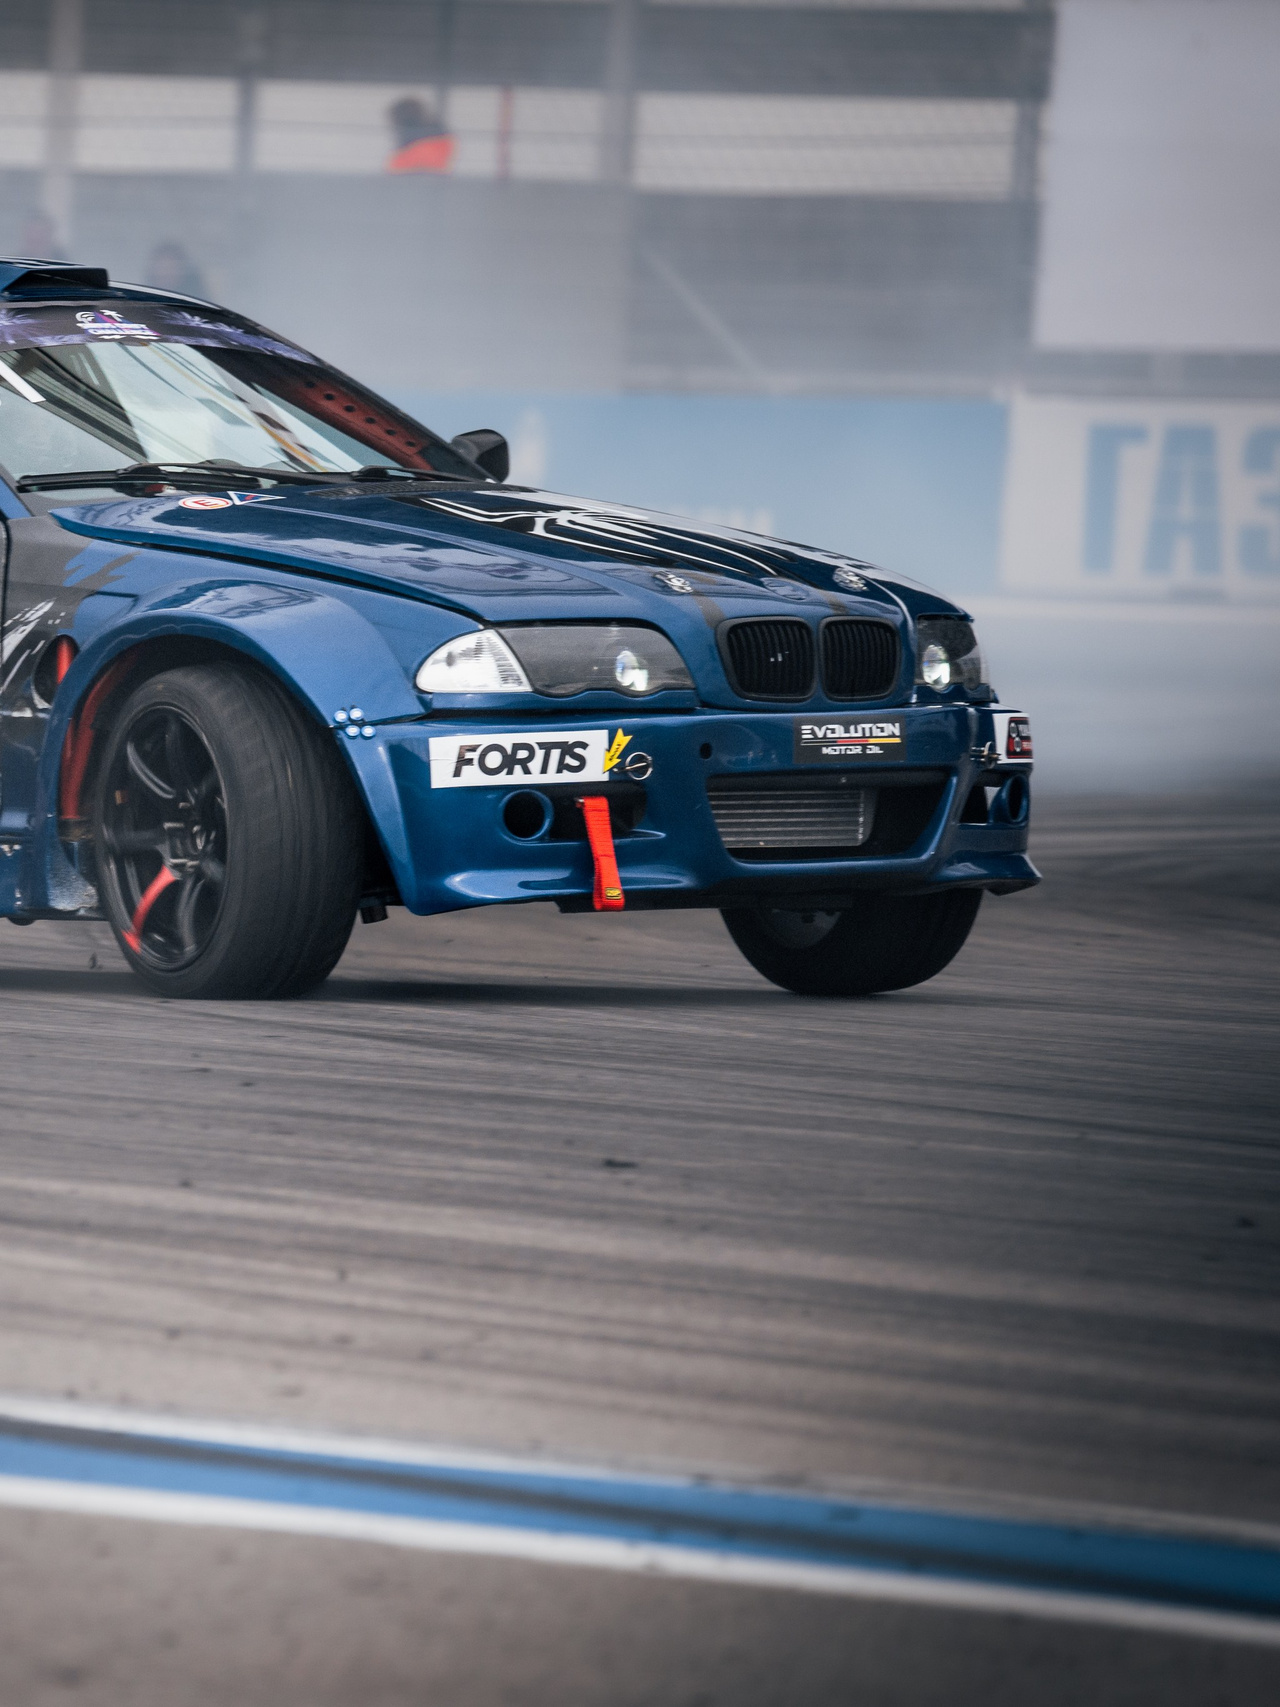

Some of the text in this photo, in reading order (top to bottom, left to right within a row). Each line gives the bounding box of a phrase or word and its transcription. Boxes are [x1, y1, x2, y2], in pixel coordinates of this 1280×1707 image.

[800, 723, 900, 738] EVOLUTION
[822, 745, 884, 754] MOTOR OIL
[453, 741, 589, 778] FORTIS
